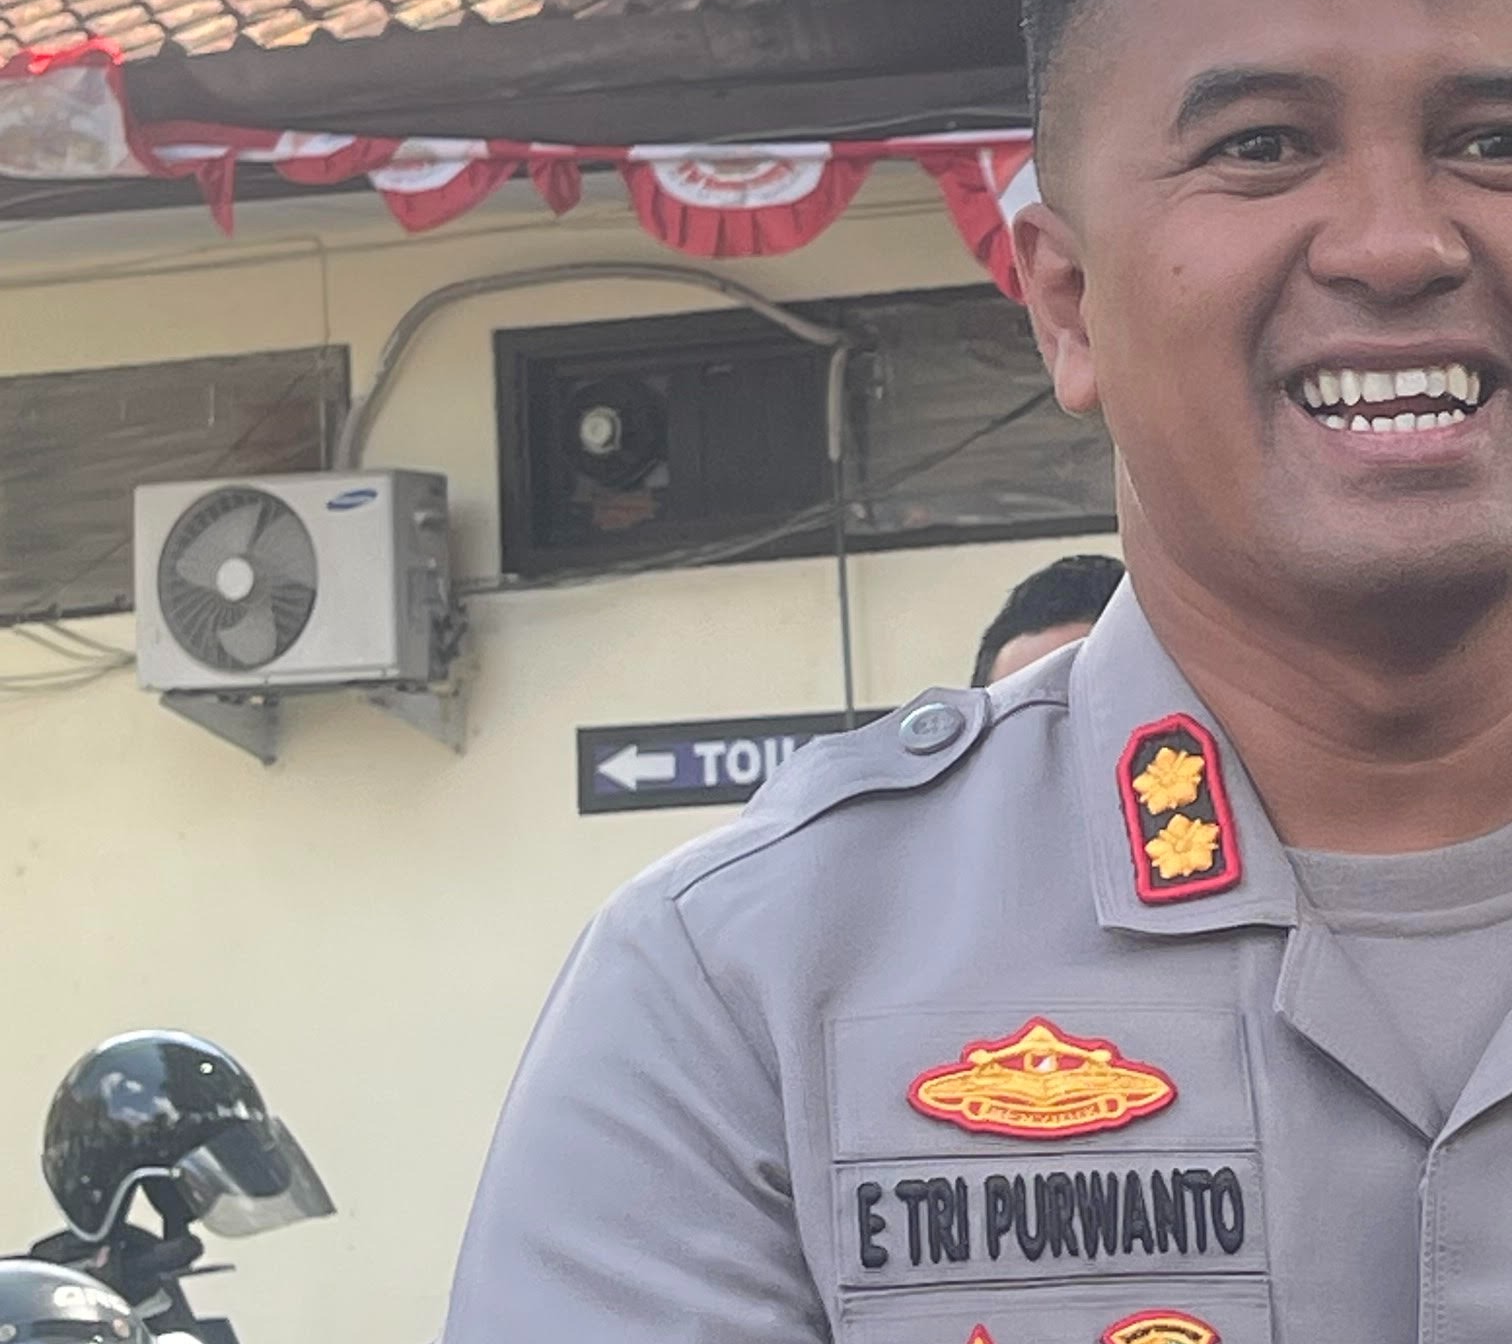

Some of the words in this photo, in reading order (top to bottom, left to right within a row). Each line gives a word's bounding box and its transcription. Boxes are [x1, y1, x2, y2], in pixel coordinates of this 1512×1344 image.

[856, 1181, 889, 1269] E
[894, 1175, 971, 1267] TRI
[982, 1166, 1246, 1263] PURWANTO
